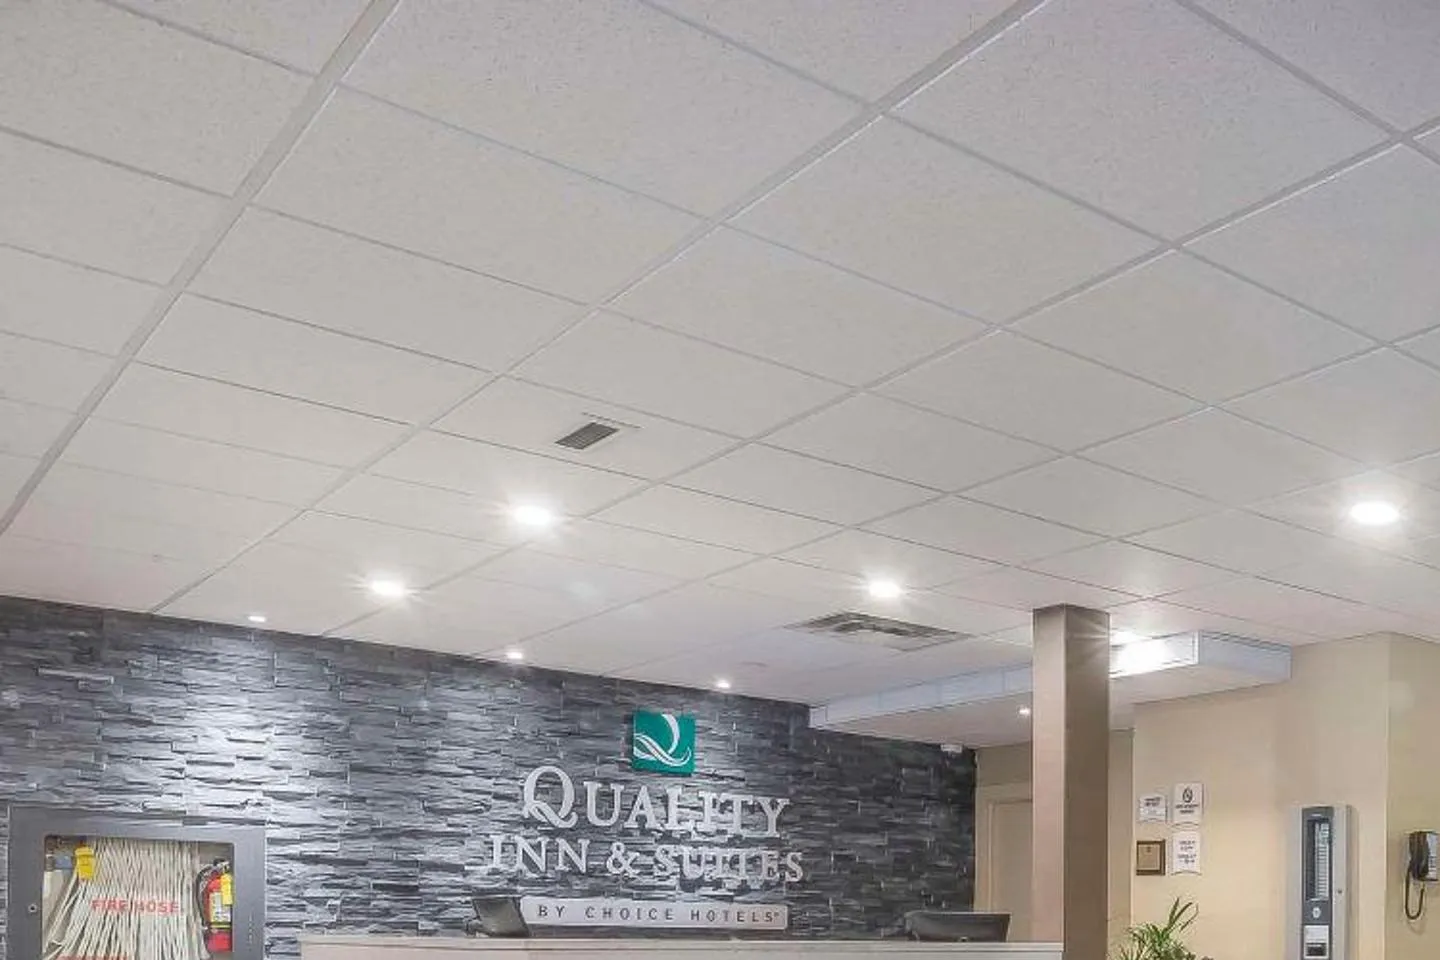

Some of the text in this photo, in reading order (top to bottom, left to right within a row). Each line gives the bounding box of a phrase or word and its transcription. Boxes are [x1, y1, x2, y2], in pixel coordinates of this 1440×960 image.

[523, 765, 789, 838] QUALITY
[489, 835, 804, 883] INN & SUITES
[91, 898, 182, 914] FIRE HOSE
[538, 904, 565, 918] BY
[584, 905, 674, 921] CHOICE
